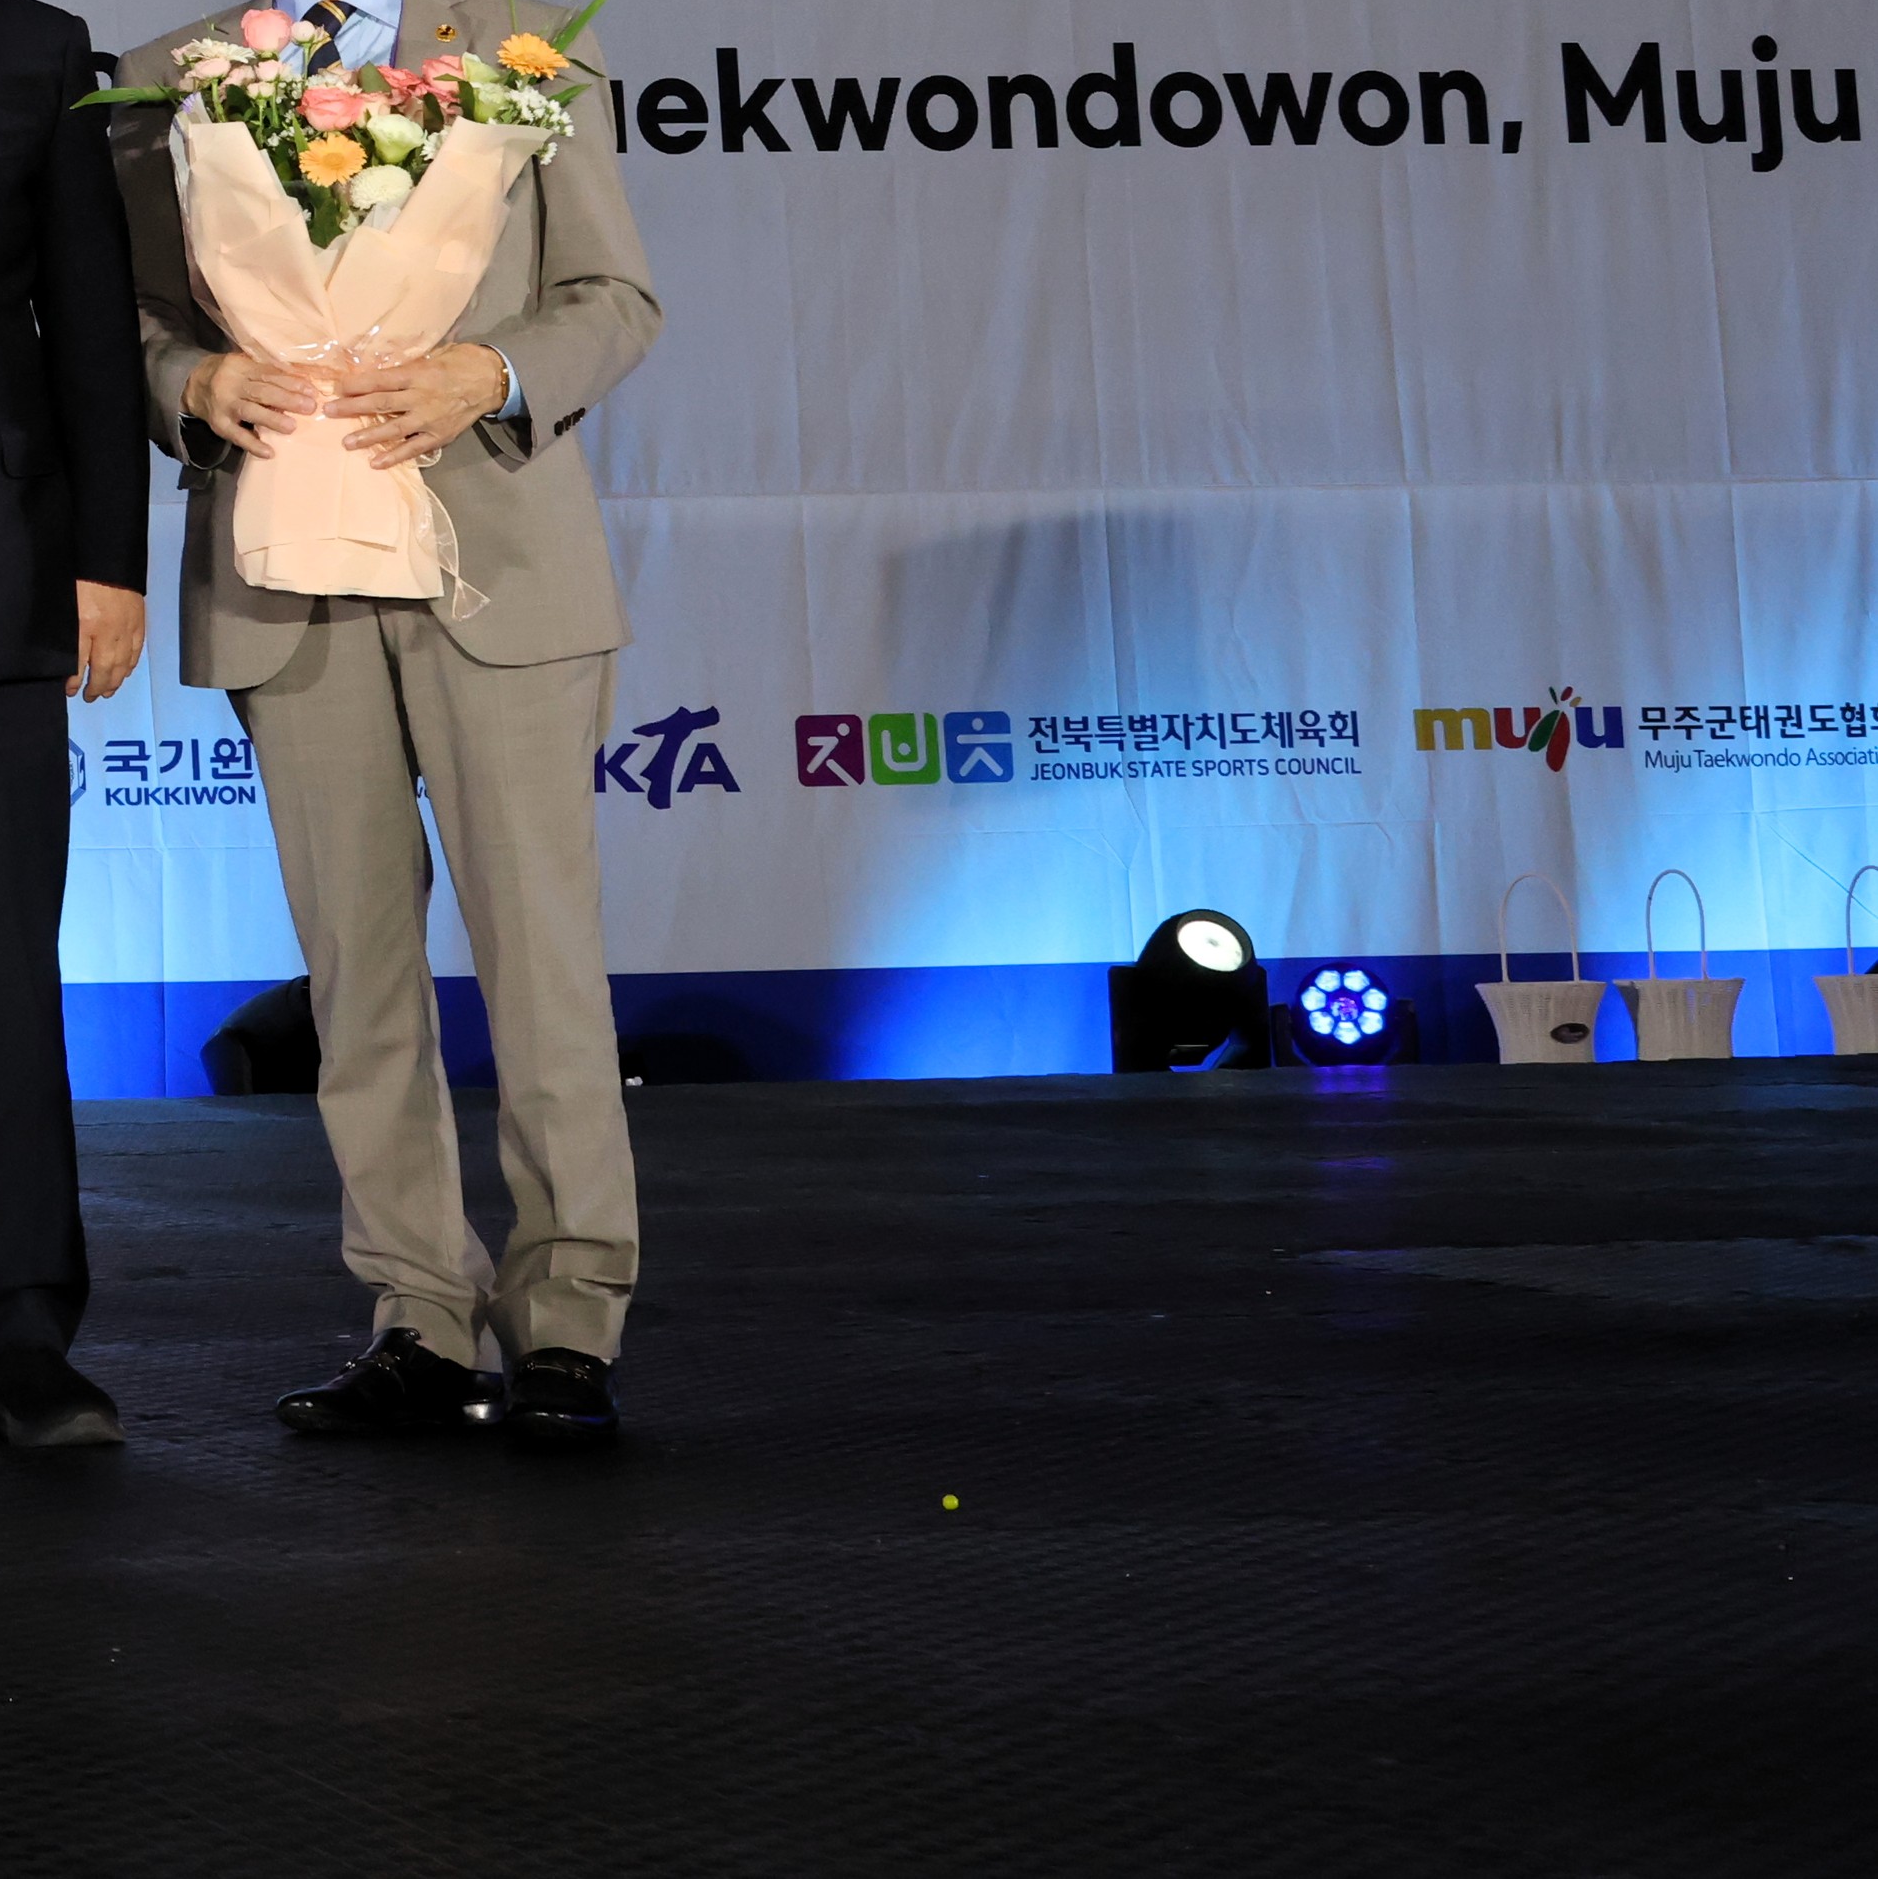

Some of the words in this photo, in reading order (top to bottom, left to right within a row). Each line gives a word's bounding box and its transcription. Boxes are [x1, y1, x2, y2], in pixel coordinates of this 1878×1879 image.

[1560, 35, 1859, 173] Muju
[1027, 709, 1361, 755] 전북특별자치도체육회
[102, 737, 255, 782] 국기원
[1030, 762, 1124, 782] JEONBUK
[1126, 760, 1187, 779] STATE
[1192, 758, 1270, 778] SPORTS
[1274, 756, 1362, 776] COUNCIL
[1644, 749, 1692, 774] Muju
[1694, 747, 1802, 769] Taekwondo
[105, 785, 257, 807] KUKKIWON
